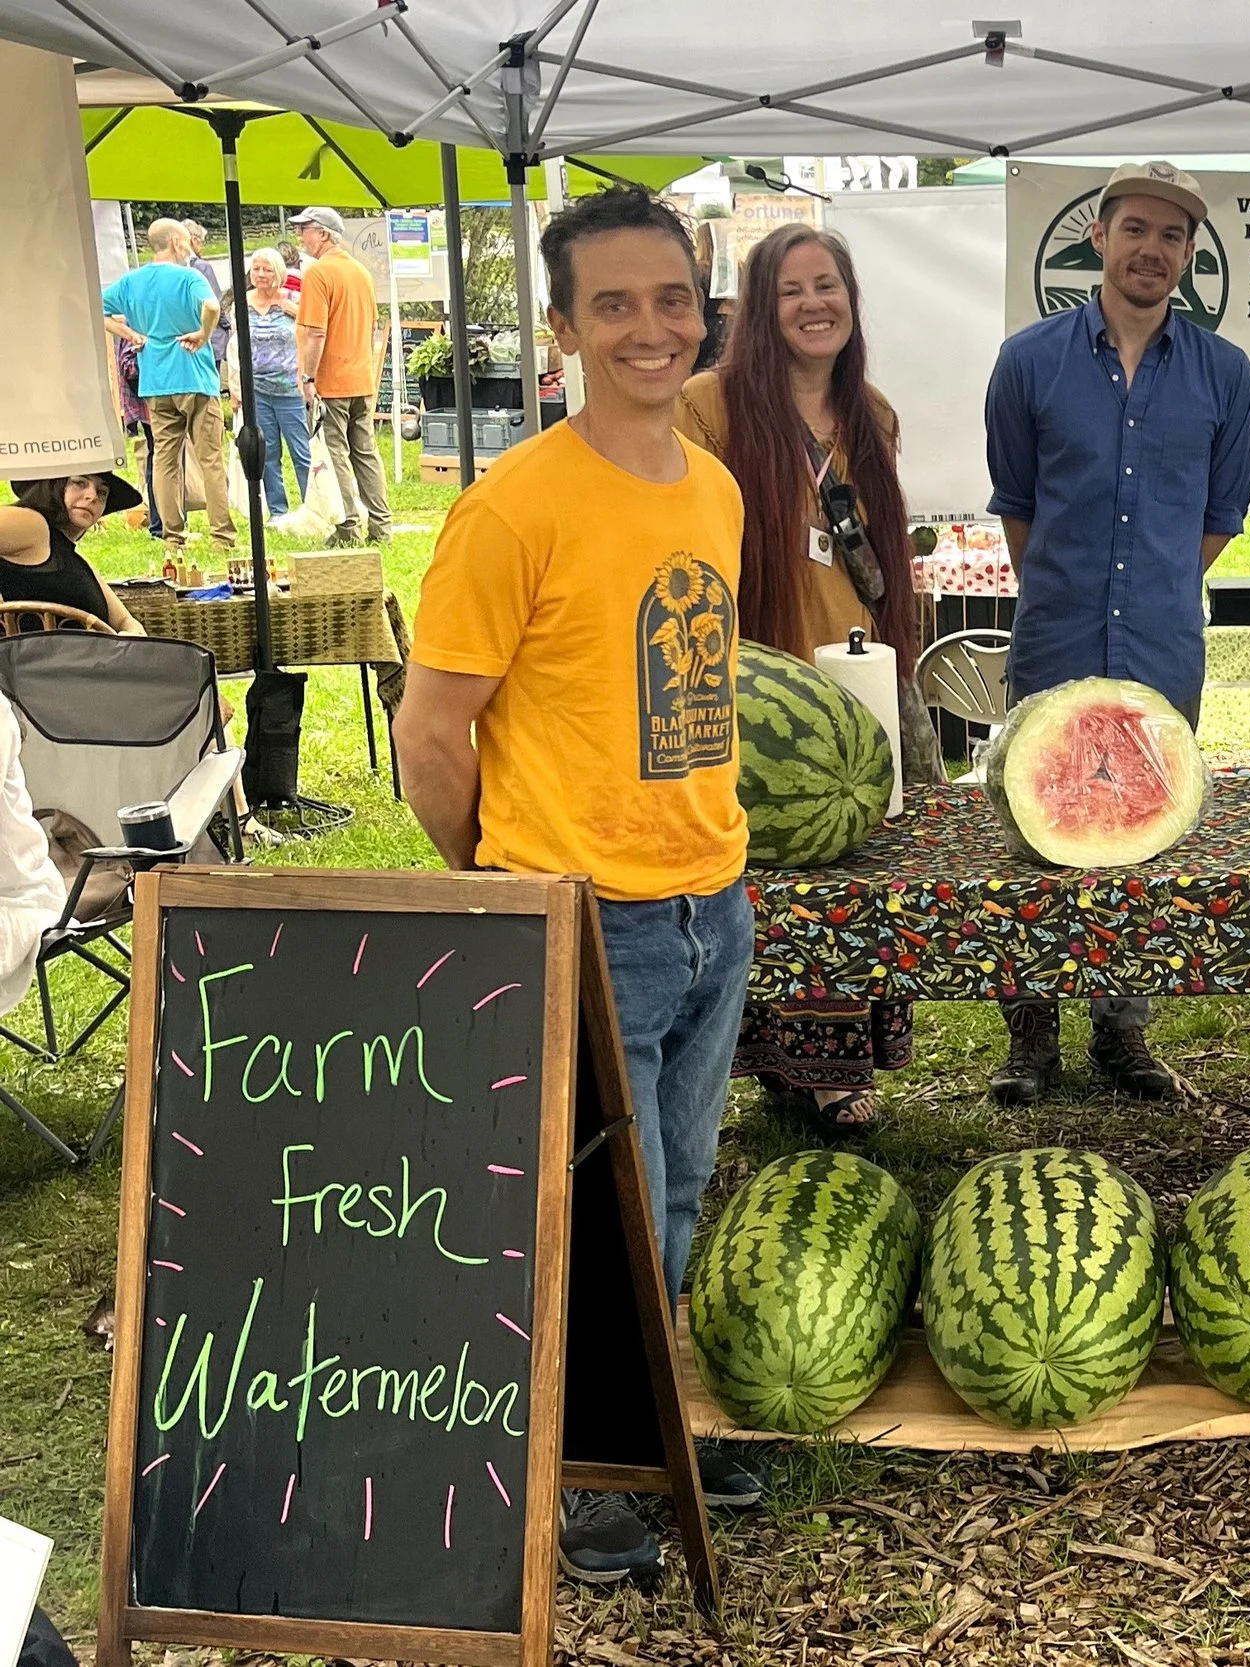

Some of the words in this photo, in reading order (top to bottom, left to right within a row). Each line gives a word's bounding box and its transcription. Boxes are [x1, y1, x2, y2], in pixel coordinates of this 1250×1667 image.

[198, 964, 453, 1103] Farm
[272, 1144, 489, 1264] Fresh
[153, 1277, 525, 1441] Watermelon
